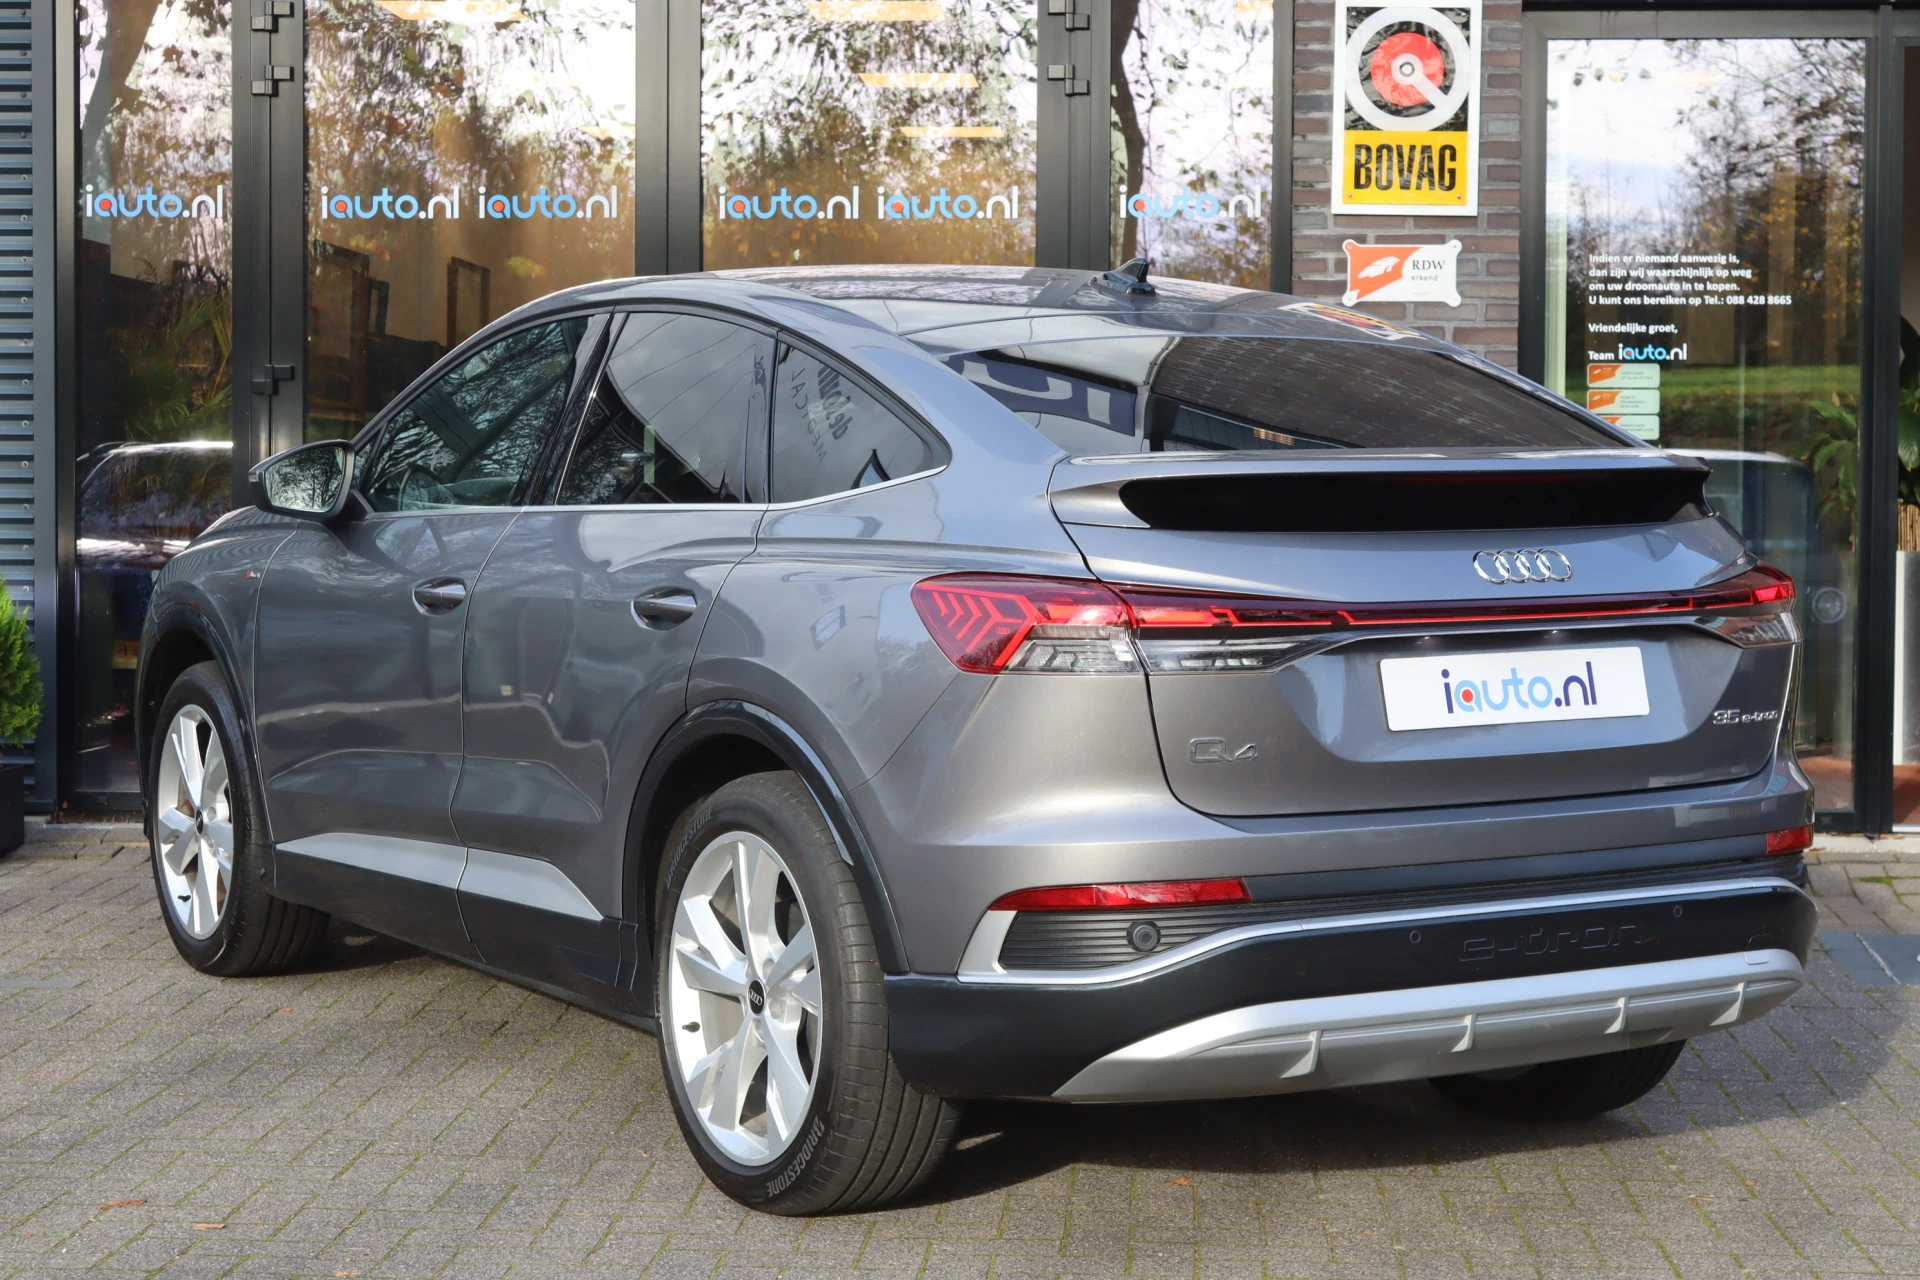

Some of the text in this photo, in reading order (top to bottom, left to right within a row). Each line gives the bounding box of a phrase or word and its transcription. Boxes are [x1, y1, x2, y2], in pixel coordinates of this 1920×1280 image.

[1354, 143, 1457, 191] BOVAG
[86, 184, 223, 218] iauto.nl
[321, 185, 460, 219] iauto.nl
[478, 185, 618, 219] iauto.nl
[719, 185, 859, 220] iauto.nl
[877, 185, 1019, 220] iauto.nl
[1120, 184, 1262, 219] iauto.nl
[1412, 259, 1446, 270] RDW
[1589, 253, 1740, 265] Indien er niemand aanwezig is,
[1589, 267, 1752, 279] dan zijn wij waarschijnlijk op weg
[1589, 281, 1740, 293] om uw droomauto in te kopen.
[1589, 295, 1792, 306] U kunt ons bereiken op Tel.: 088 428 8665
[1588, 323, 1678, 335] Vriendelijke groet,
[1588, 343, 1687, 360] Team iauto.nl
[1441, 661, 1598, 714] iauto.nl
[1712, 709, 1740, 725] 35
[1190, 737, 1258, 763] Q4
[1458, 925, 1643, 962] e-tron
[765, 1115, 825, 1198] BRIDGESTONE
